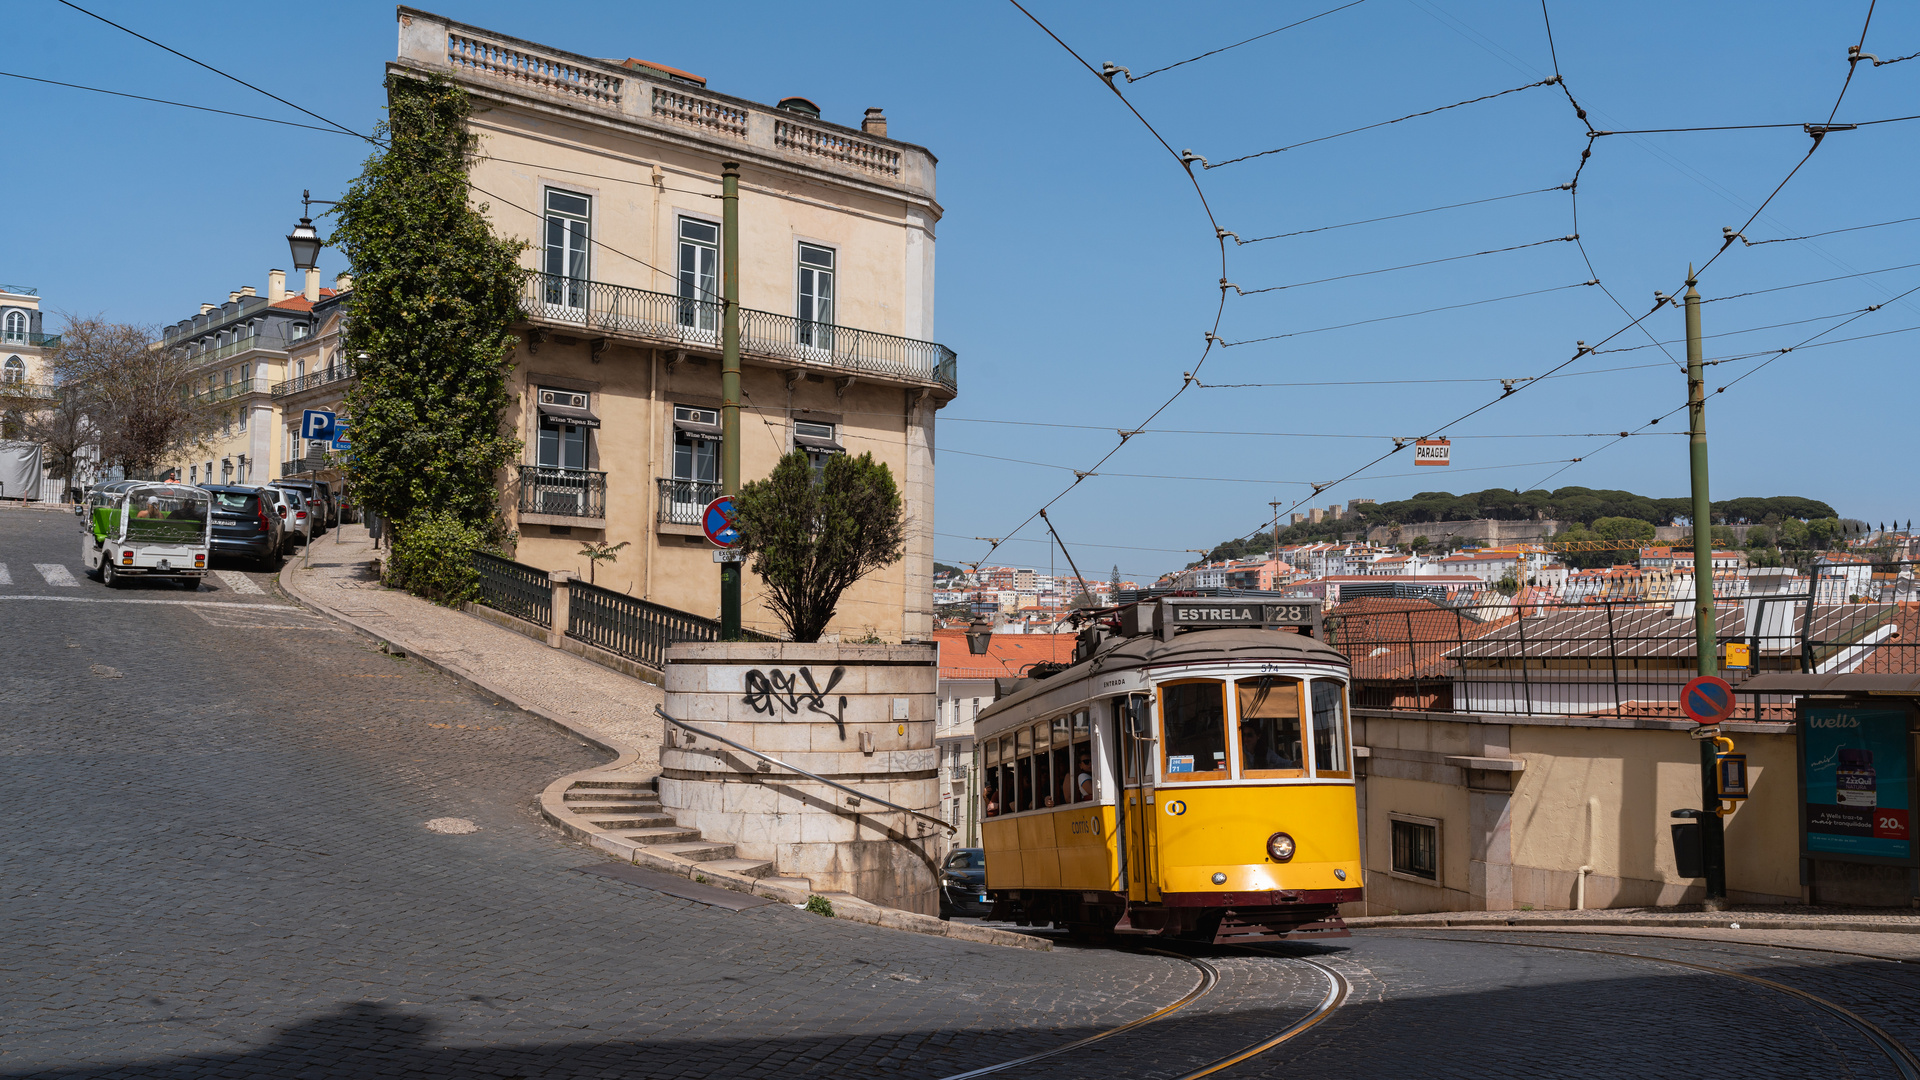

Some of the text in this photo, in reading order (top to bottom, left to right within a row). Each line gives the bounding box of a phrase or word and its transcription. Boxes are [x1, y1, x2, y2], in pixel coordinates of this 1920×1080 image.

[308, 413, 328, 437] P
[549, 416, 566, 424] Wine
[567, 418, 586, 427] Tapas
[685, 431, 701, 439] Wine
[700, 433, 719, 441] Tapas
[1417, 447, 1449, 458] PARAGEM
[1178, 605, 1302, 622] ESTRELA 28
[1260, 663, 1279, 673] 574
[1103, 678, 1126, 688] ENTRADA
